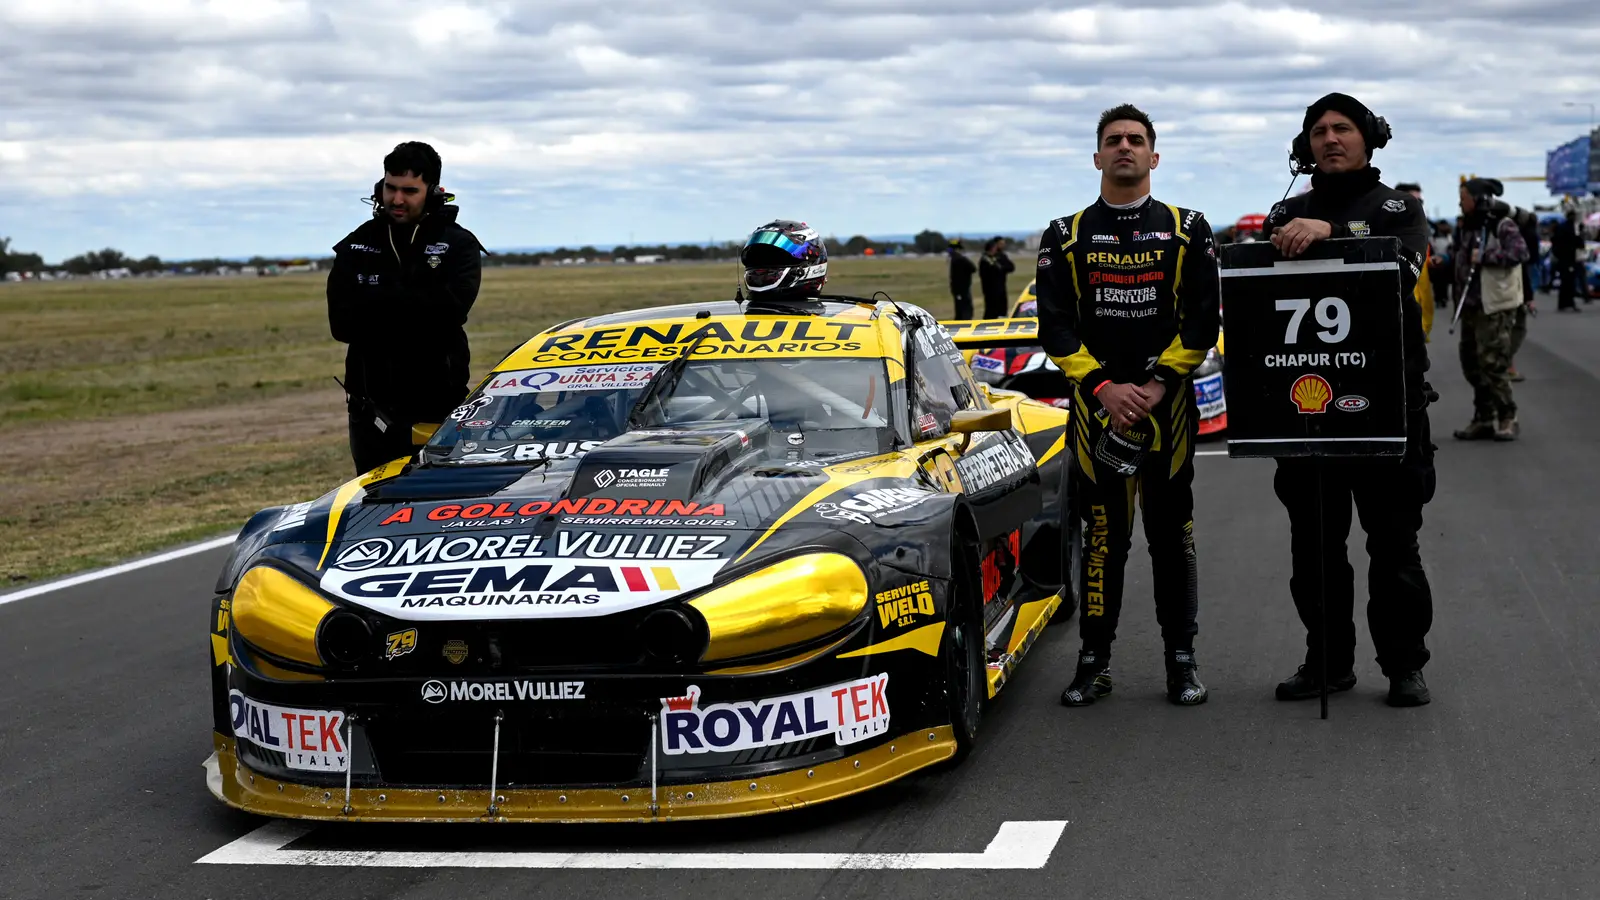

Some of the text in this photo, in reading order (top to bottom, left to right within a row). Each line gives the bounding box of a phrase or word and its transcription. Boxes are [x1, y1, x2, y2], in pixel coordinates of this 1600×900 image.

[1086, 250, 1165, 265] RENAULT
[1098, 261, 1155, 270] CONCESIONARIOS
[1136, 271, 1165, 283] PAGID
[1103, 286, 1157, 296] FERRETERA
[1103, 293, 1157, 304] SAN LUIS
[1103, 307, 1158, 318] MOREL VULLIEZ
[1275, 297, 1351, 344] 79
[536, 320, 872, 353] RENAULT
[532, 341, 861, 363] CONCESIONARIOS
[1264, 352, 1367, 368] CHAPUR (TC)
[575, 365, 654, 375] Servicios
[511, 419, 571, 427] CRISTEM
[1125, 430, 1147, 441] AULT
[617, 469, 670, 478] TAGLE
[959, 440, 1024, 493] FERRETERA
[379, 497, 726, 526] A GOLONDRINA
[441, 516, 738, 528] JAULAS Y SEMIRREMOLQUES
[387, 530, 727, 566] MOREL VULLIEZ
[341, 565, 620, 598] GEMA
[875, 580, 930, 604] SERVICE
[400, 594, 601, 609] MAQUINARIAS
[877, 592, 935, 629] WELD
[387, 629, 416, 656] 79
[450, 680, 586, 701] MOREL VULLIEZ
[839, 718, 888, 742] ITALY
[287, 754, 345, 768] ITALY
